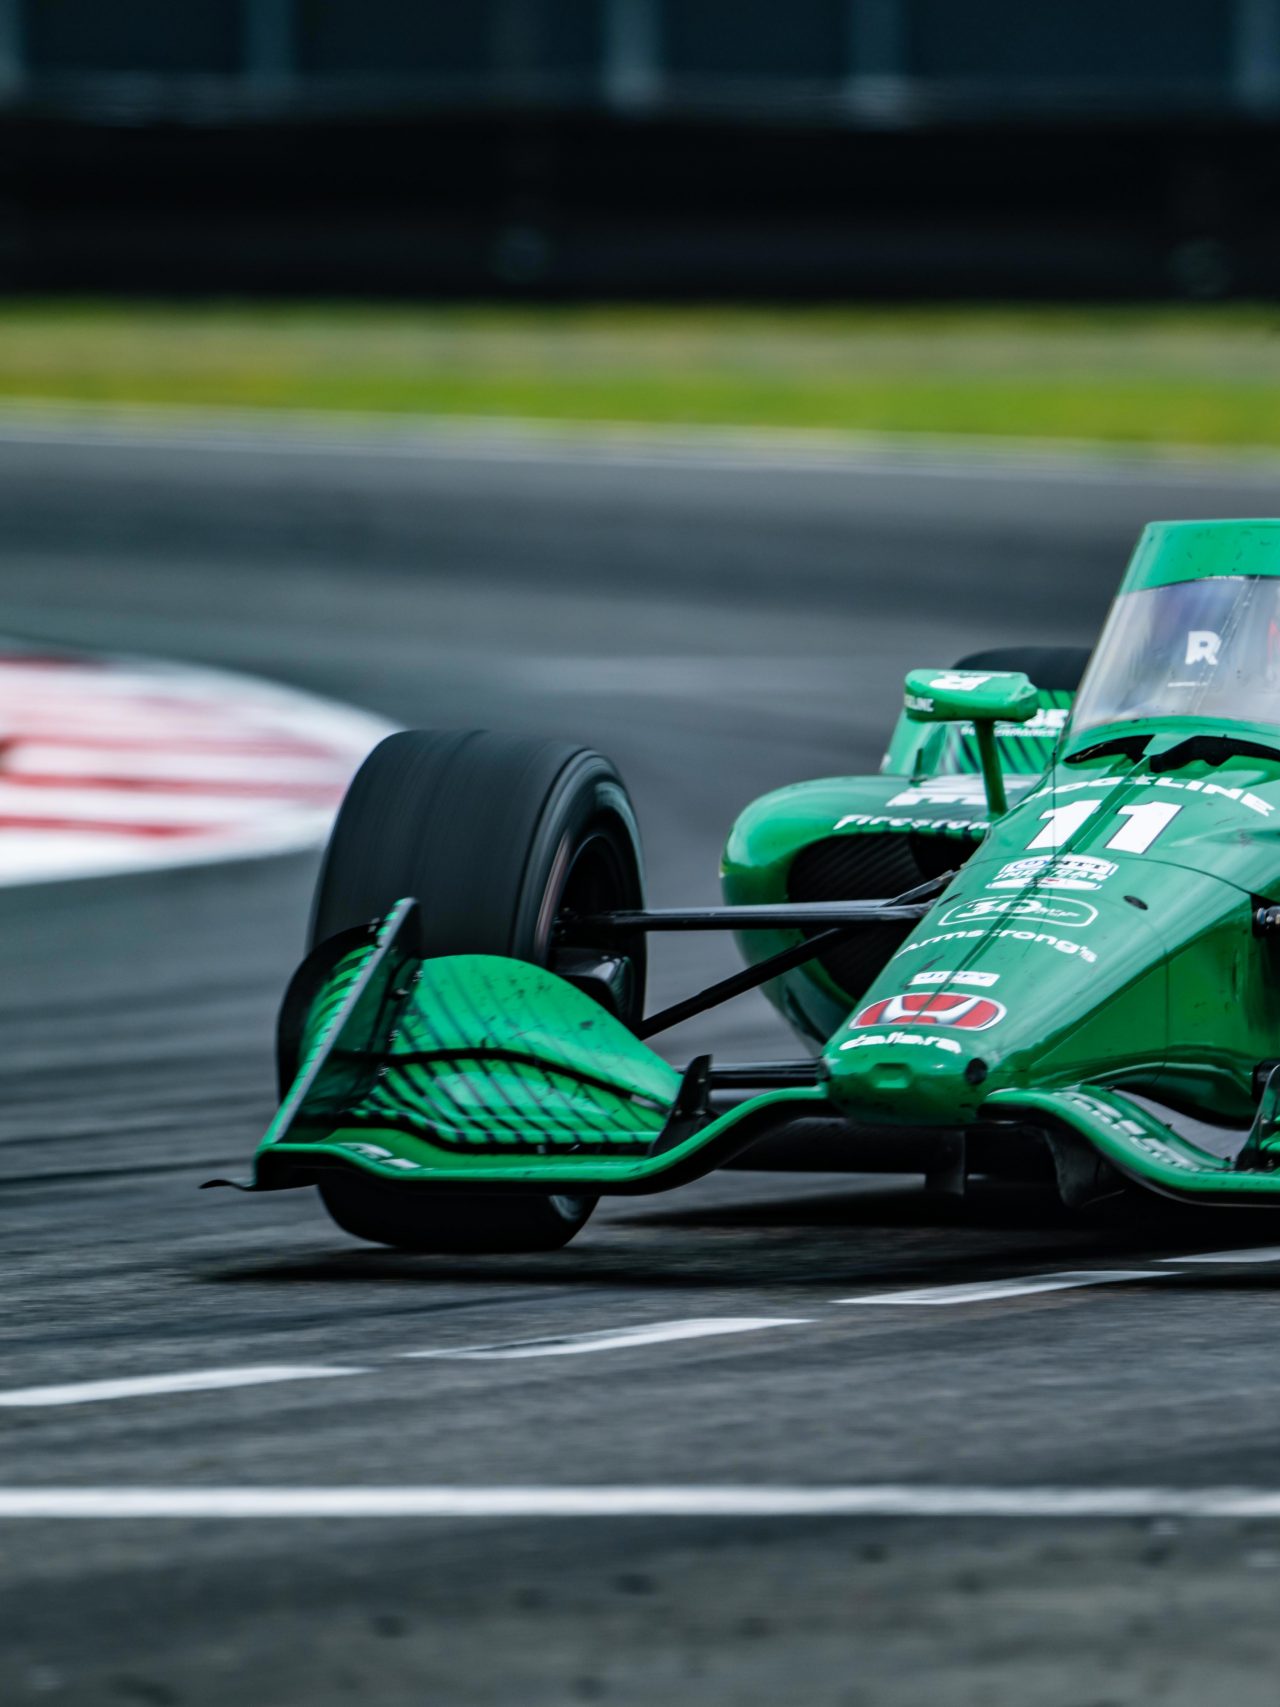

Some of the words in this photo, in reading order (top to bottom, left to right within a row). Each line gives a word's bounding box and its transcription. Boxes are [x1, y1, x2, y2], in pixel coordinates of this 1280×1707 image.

[1185, 631, 1222, 665] R
[1024, 800, 1184, 855] 11
[839, 1031, 962, 1055] dallara
